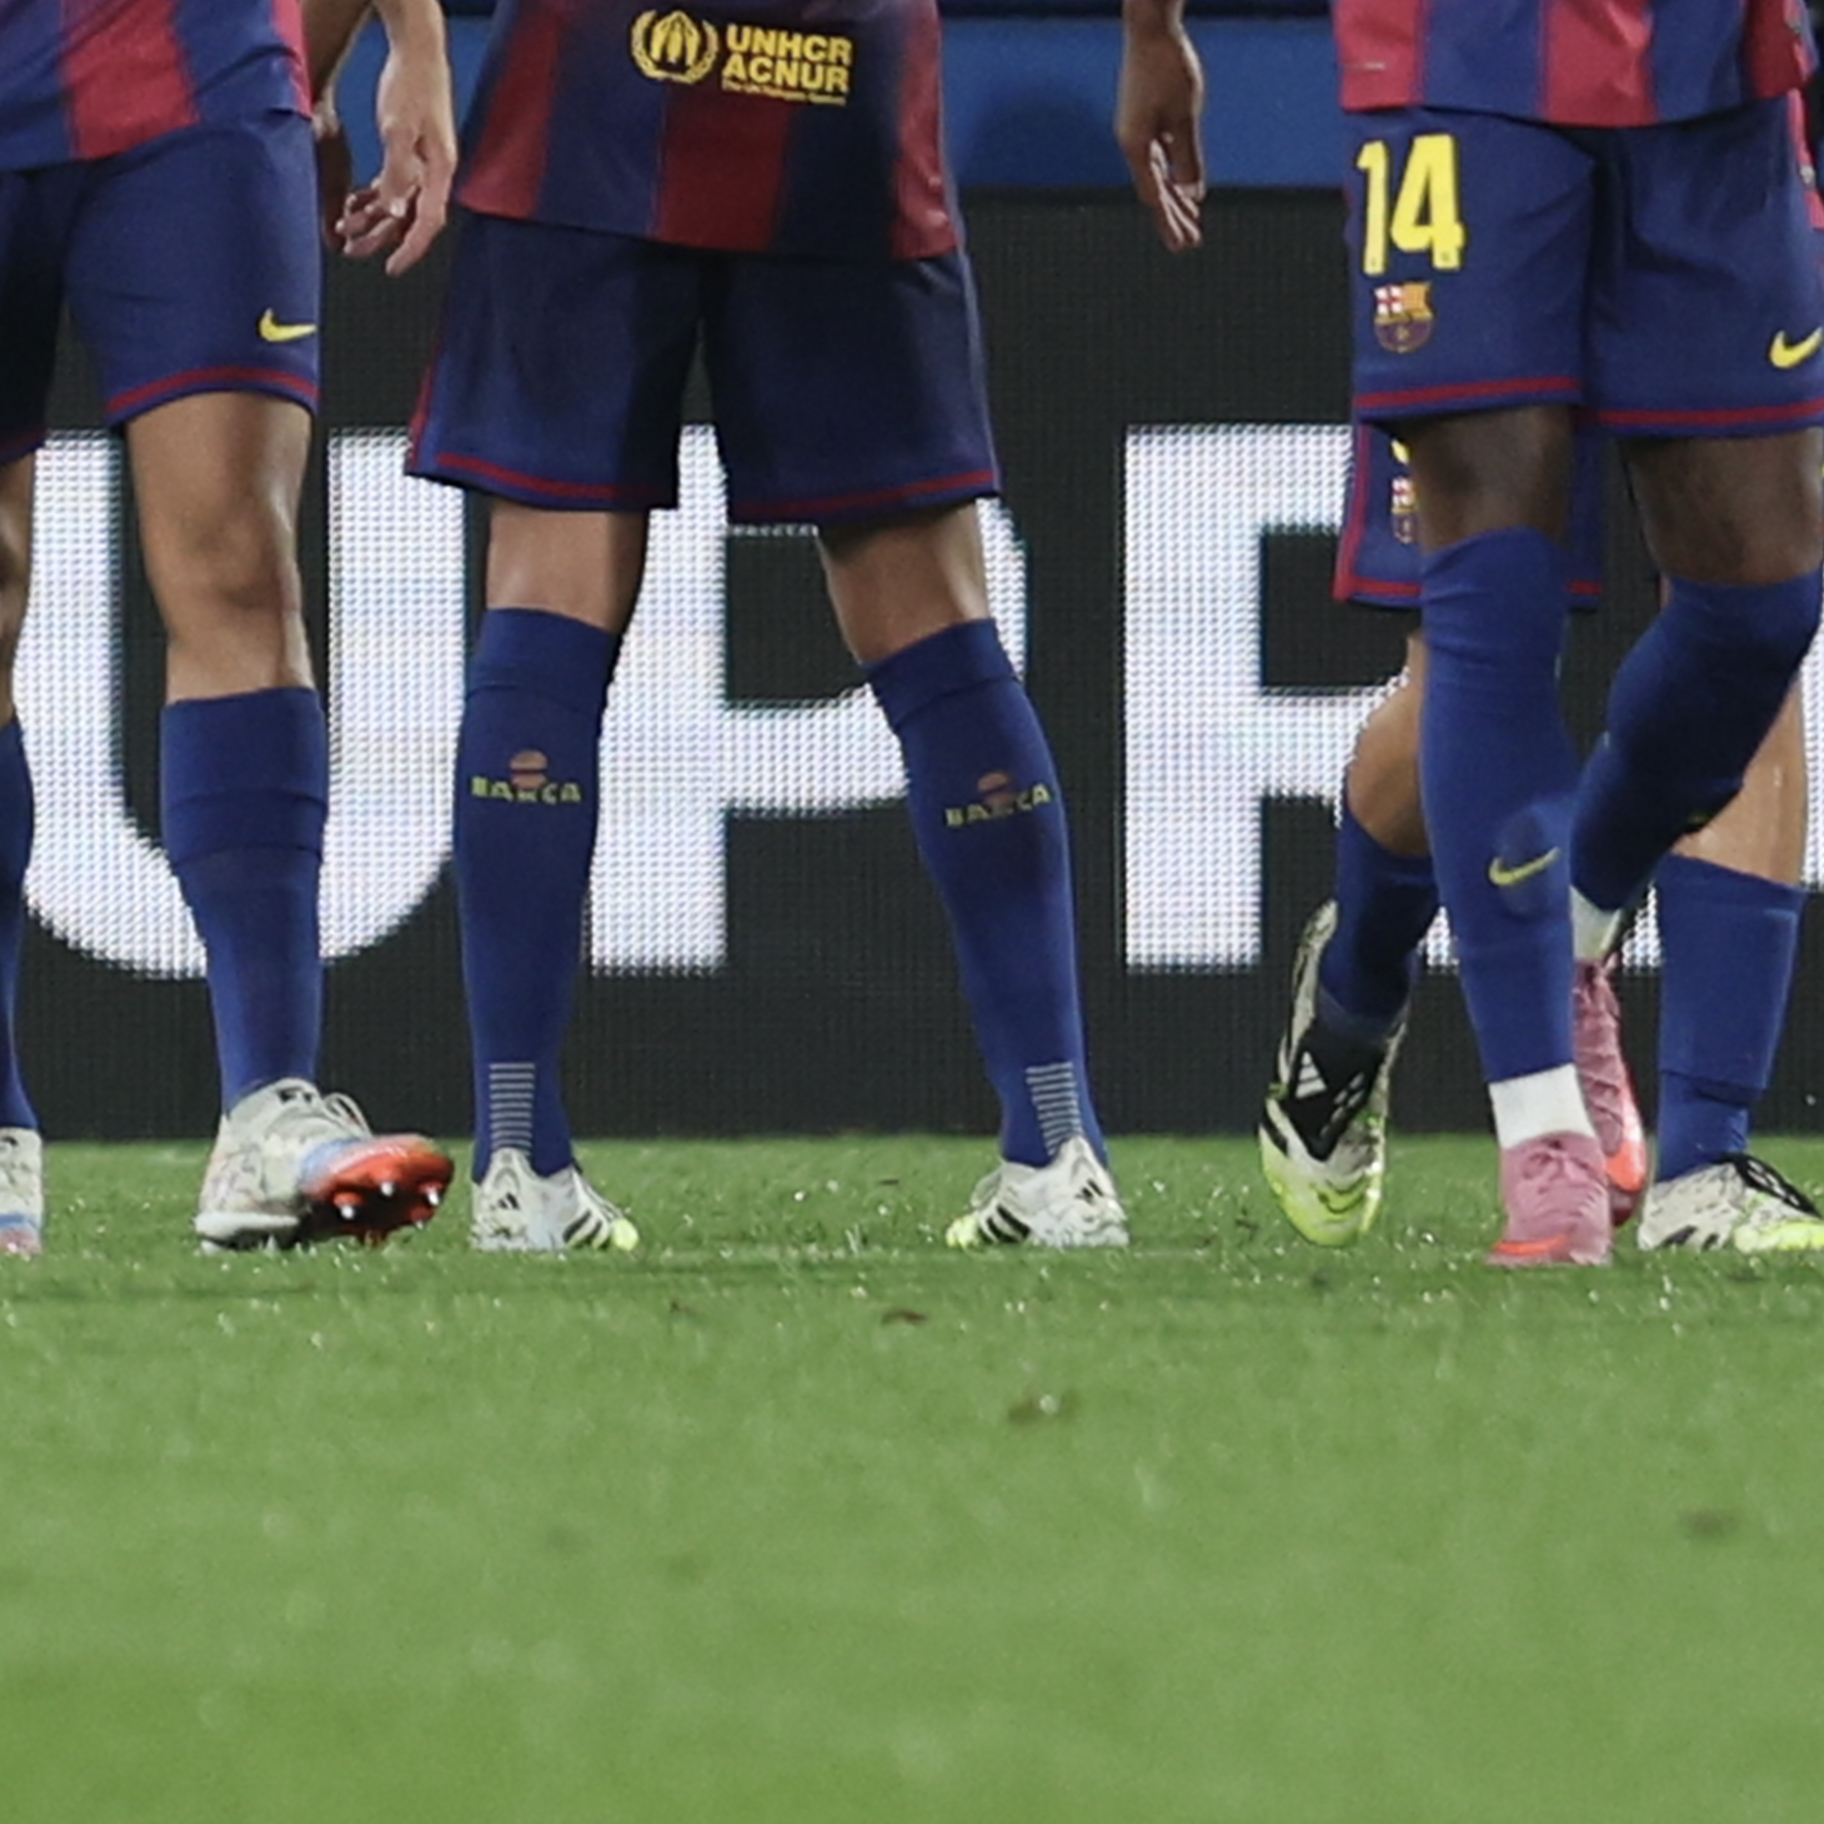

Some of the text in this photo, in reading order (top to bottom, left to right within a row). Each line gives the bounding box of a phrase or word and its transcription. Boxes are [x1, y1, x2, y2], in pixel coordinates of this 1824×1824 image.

[725, 22, 853, 67] UNHCR
[722, 52, 850, 94] ACNUR
[1356, 132, 1466, 276] 14
